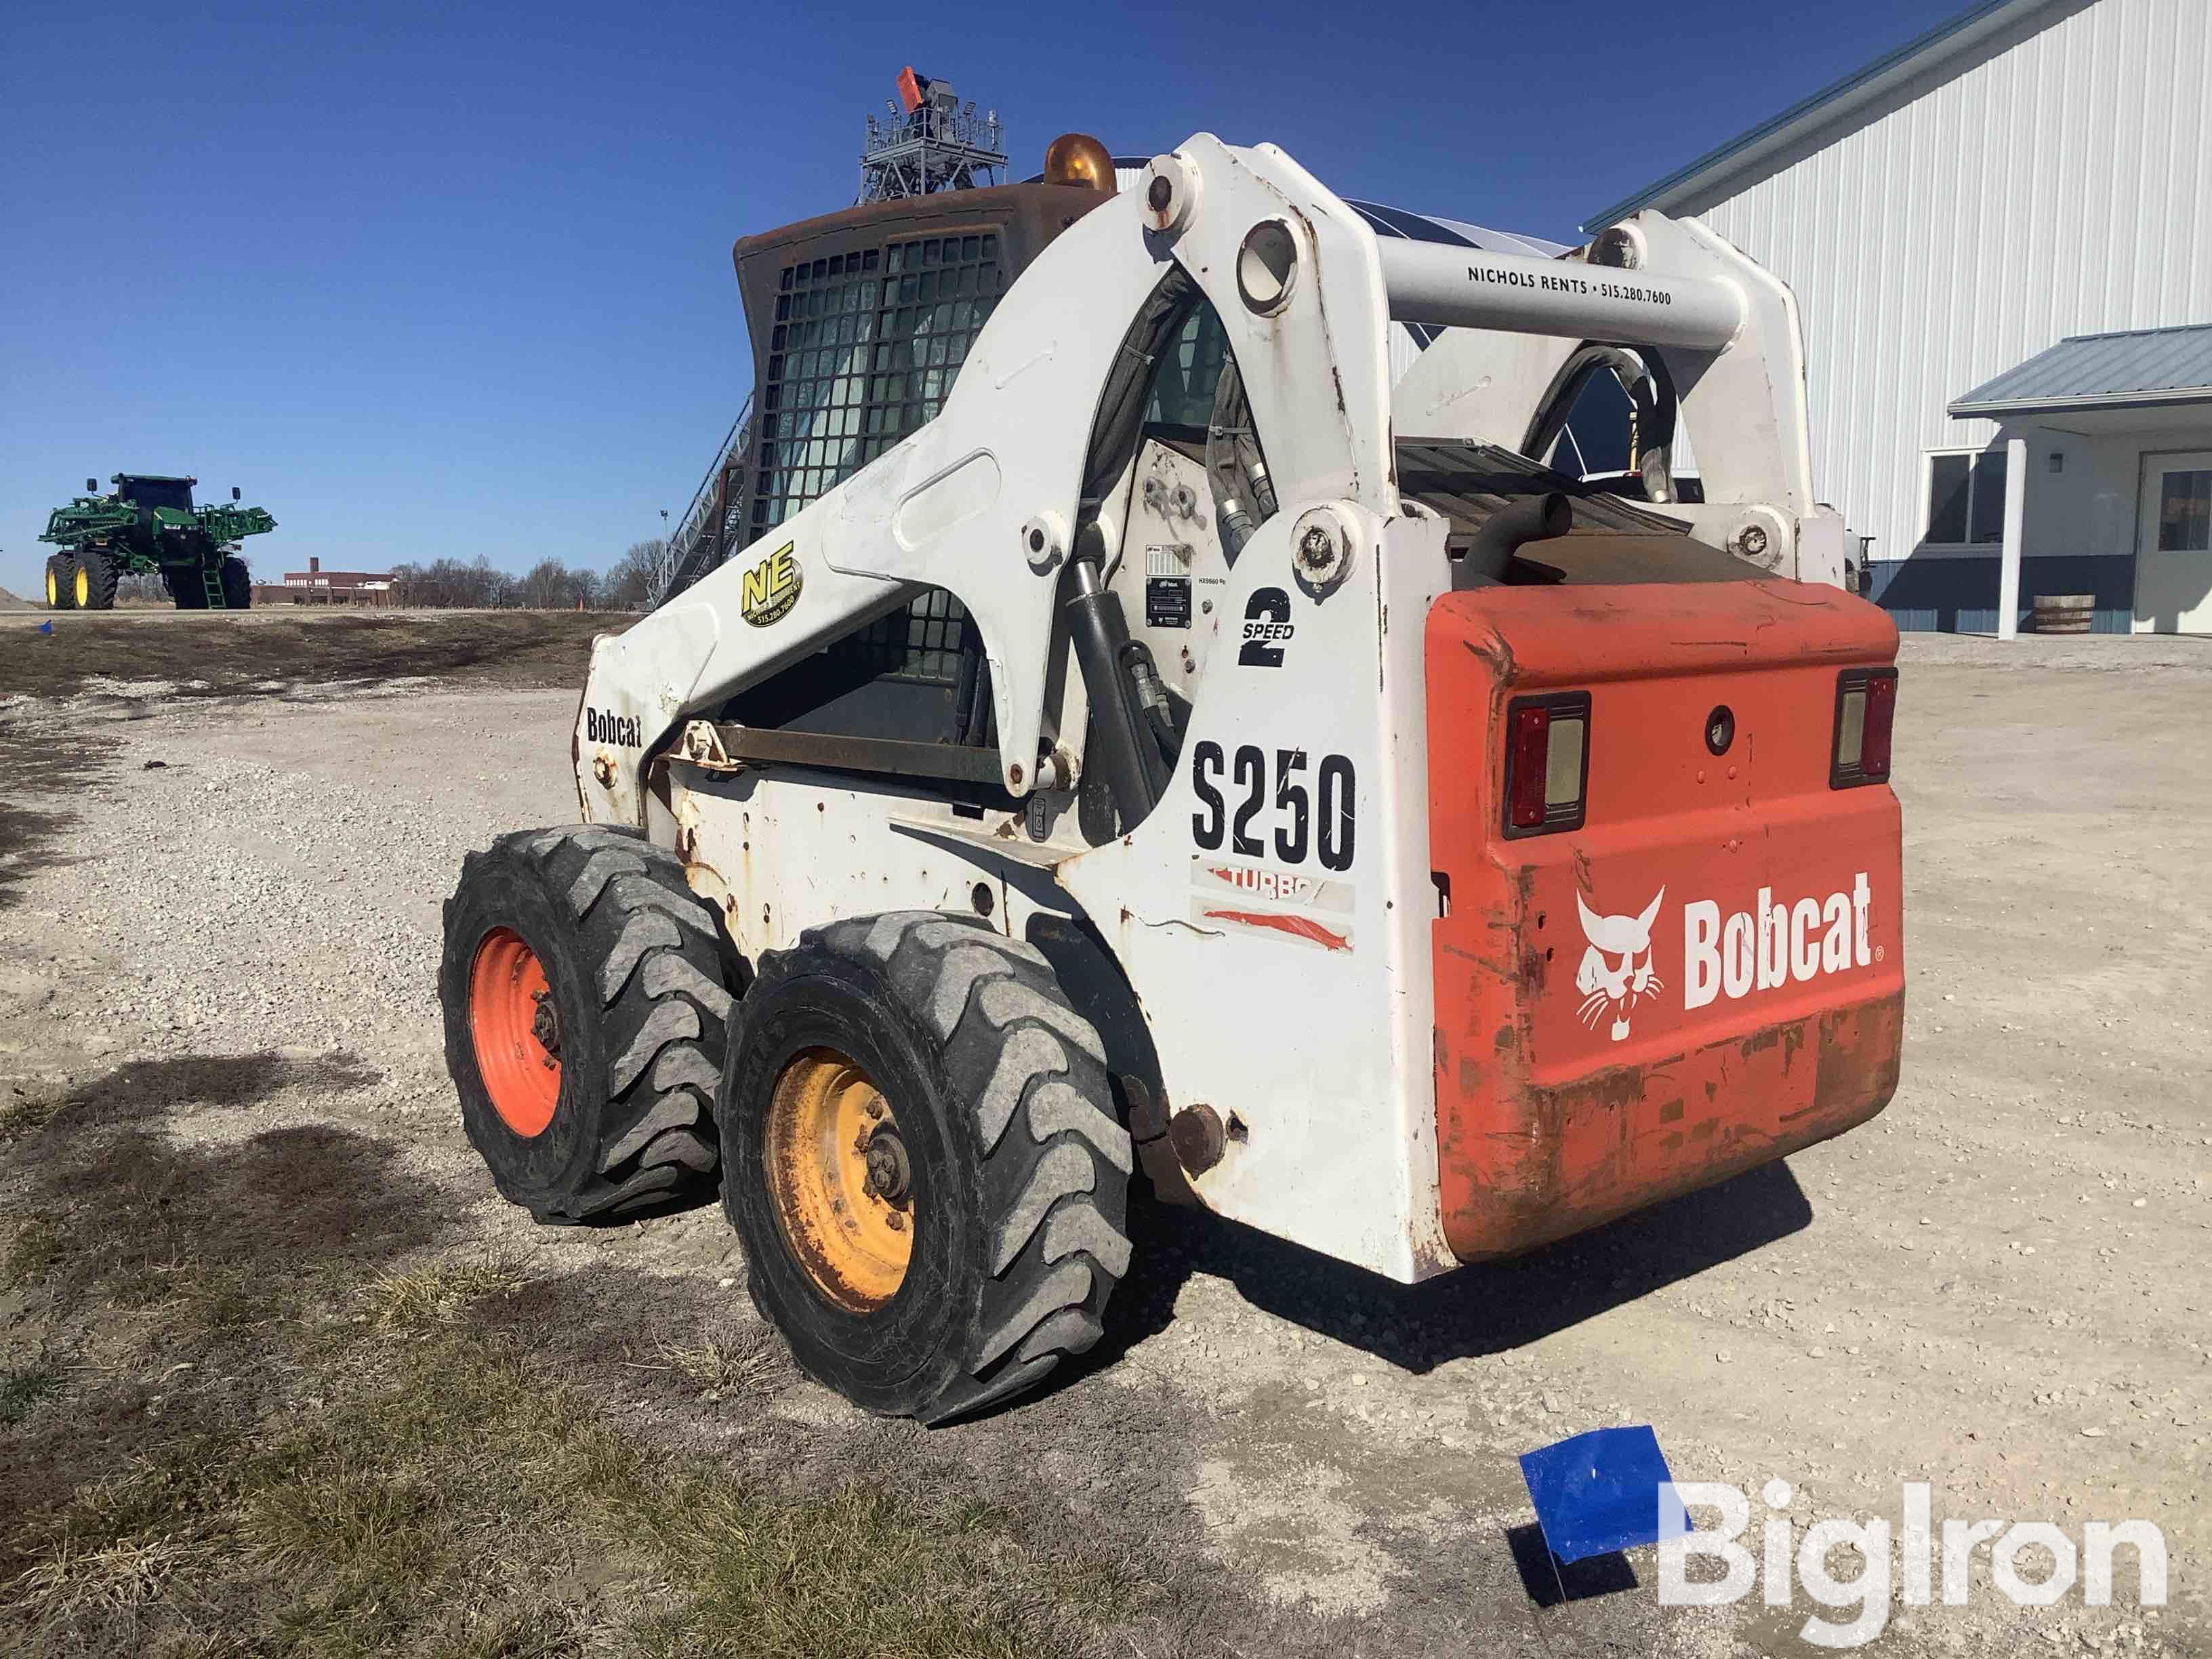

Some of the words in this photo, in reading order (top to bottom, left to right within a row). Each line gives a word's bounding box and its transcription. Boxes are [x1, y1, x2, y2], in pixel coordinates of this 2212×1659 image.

[1467, 266, 1535, 288] NICHOLS
[1541, 275, 1587, 294] RENTS
[1601, 283, 1671, 306] 515.280.7600
[741, 539, 794, 617] NE
[1242, 623, 1294, 640] SPEED
[587, 707, 642, 749] Bobcat
[1191, 740, 1356, 872] S250
[1684, 872, 1872, 1010] Bobcat
